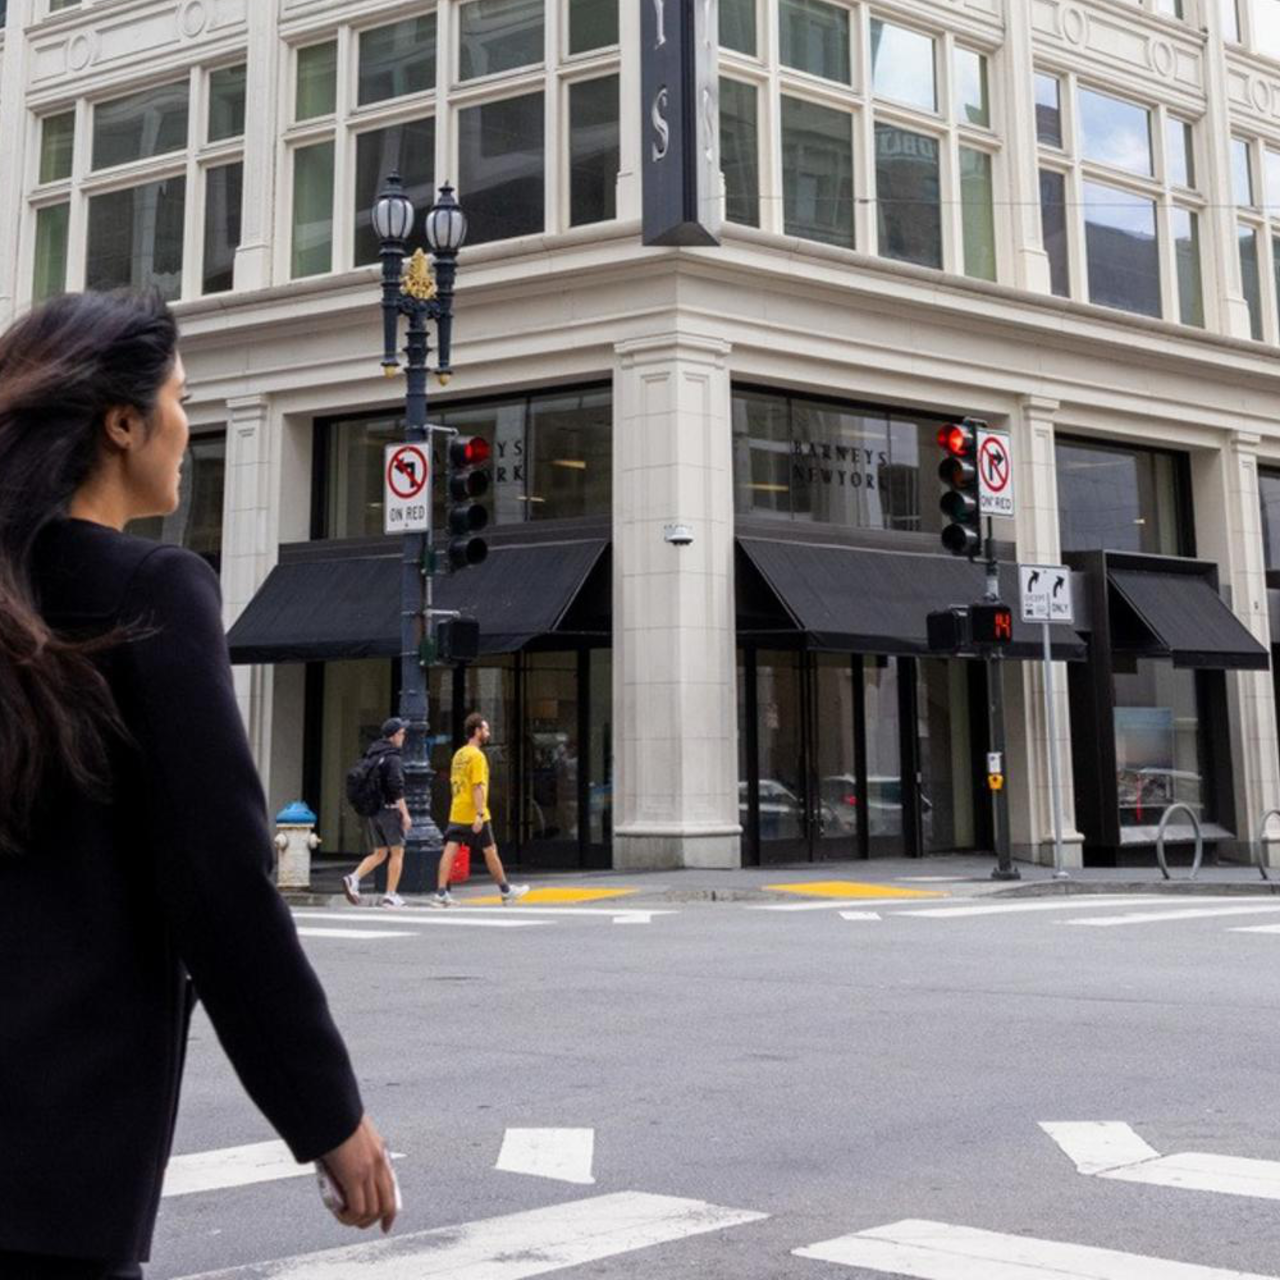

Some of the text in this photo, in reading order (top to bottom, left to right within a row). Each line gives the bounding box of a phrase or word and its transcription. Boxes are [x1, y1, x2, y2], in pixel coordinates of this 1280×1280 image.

[792, 440, 888, 468] BARNEYS
[390, 505, 425, 523] ON RED
[995, 497, 1011, 510] RED
[995, 612, 1011, 639] 14
